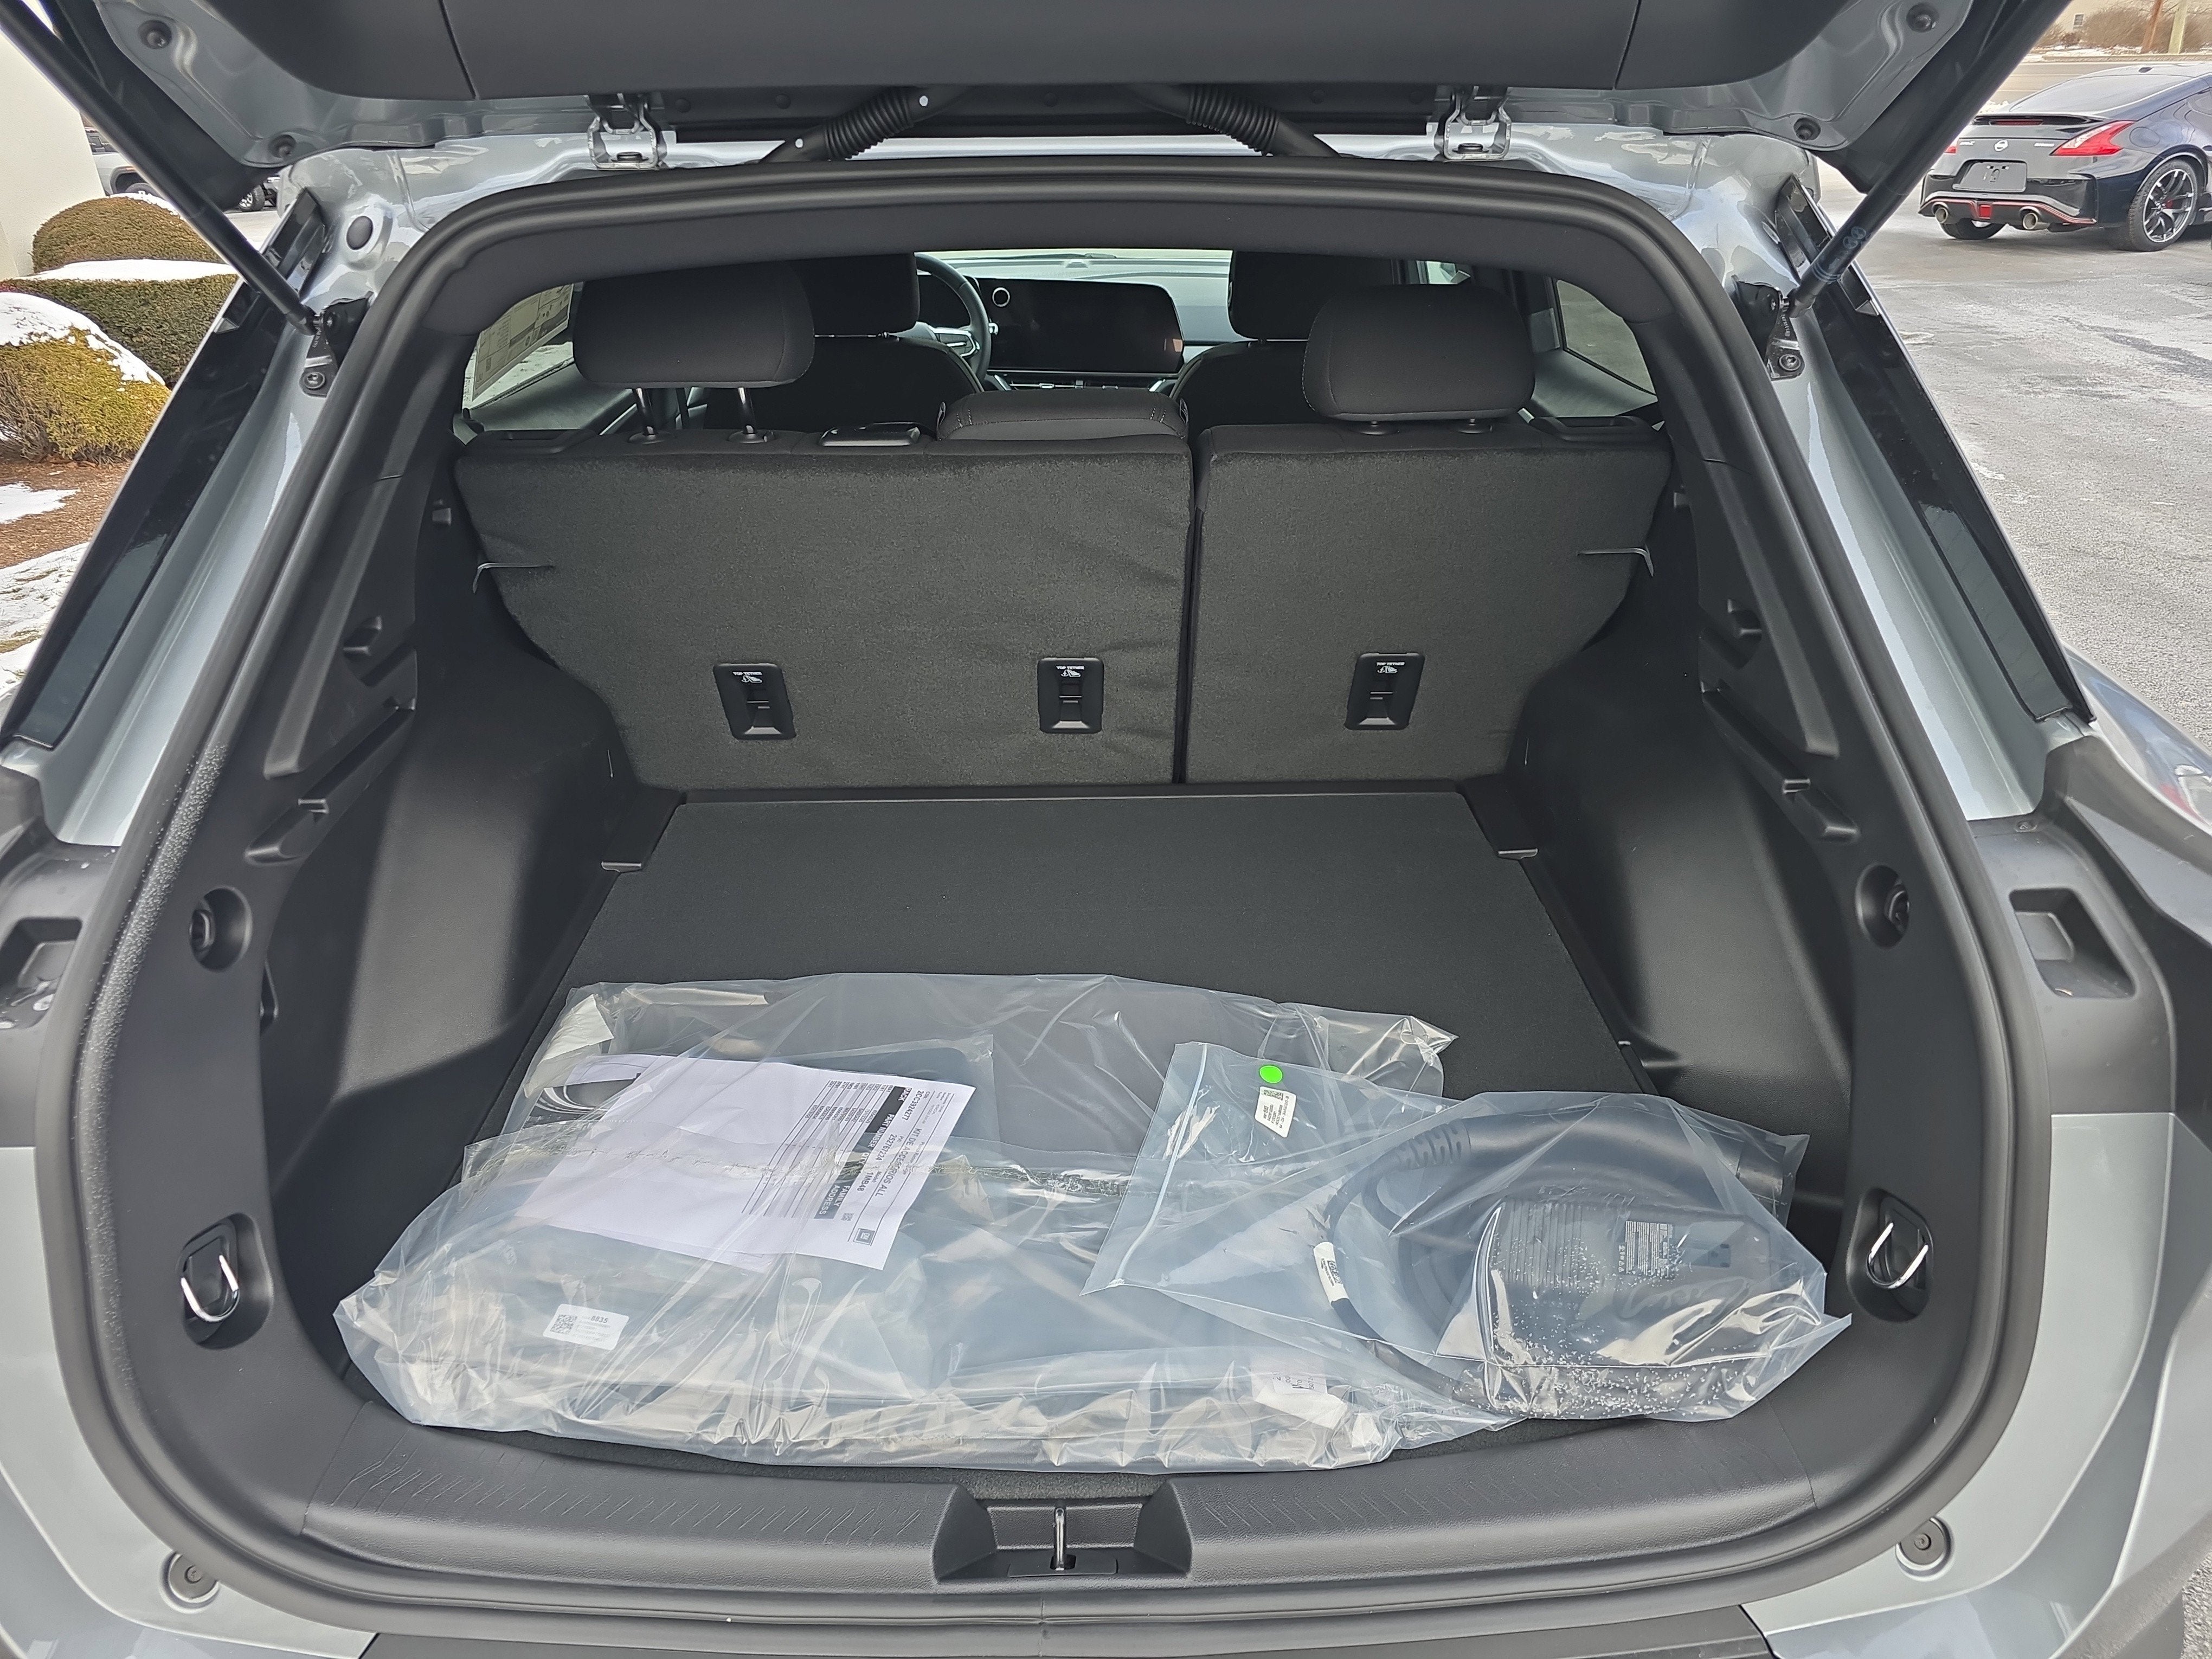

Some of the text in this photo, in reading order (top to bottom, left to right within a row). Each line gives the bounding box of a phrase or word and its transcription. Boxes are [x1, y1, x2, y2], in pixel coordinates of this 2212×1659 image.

[897, 1088, 911, 1101] RACK
[901, 1090, 924, 1120] 2CC3924277
[867, 1114, 894, 1147] PART NUMBER
[910, 1128, 922, 1136] KIT
[874, 1134, 897, 1160] 252767224
[905, 1137, 916, 1146] DE
[856, 1172, 873, 1191] 1MB48
[874, 1184, 888, 1197] ALL
[818, 1185, 840, 1214] ADDRESS
[832, 1185, 850, 1206] FAMILY
[590, 1315, 609, 1323] 8835
